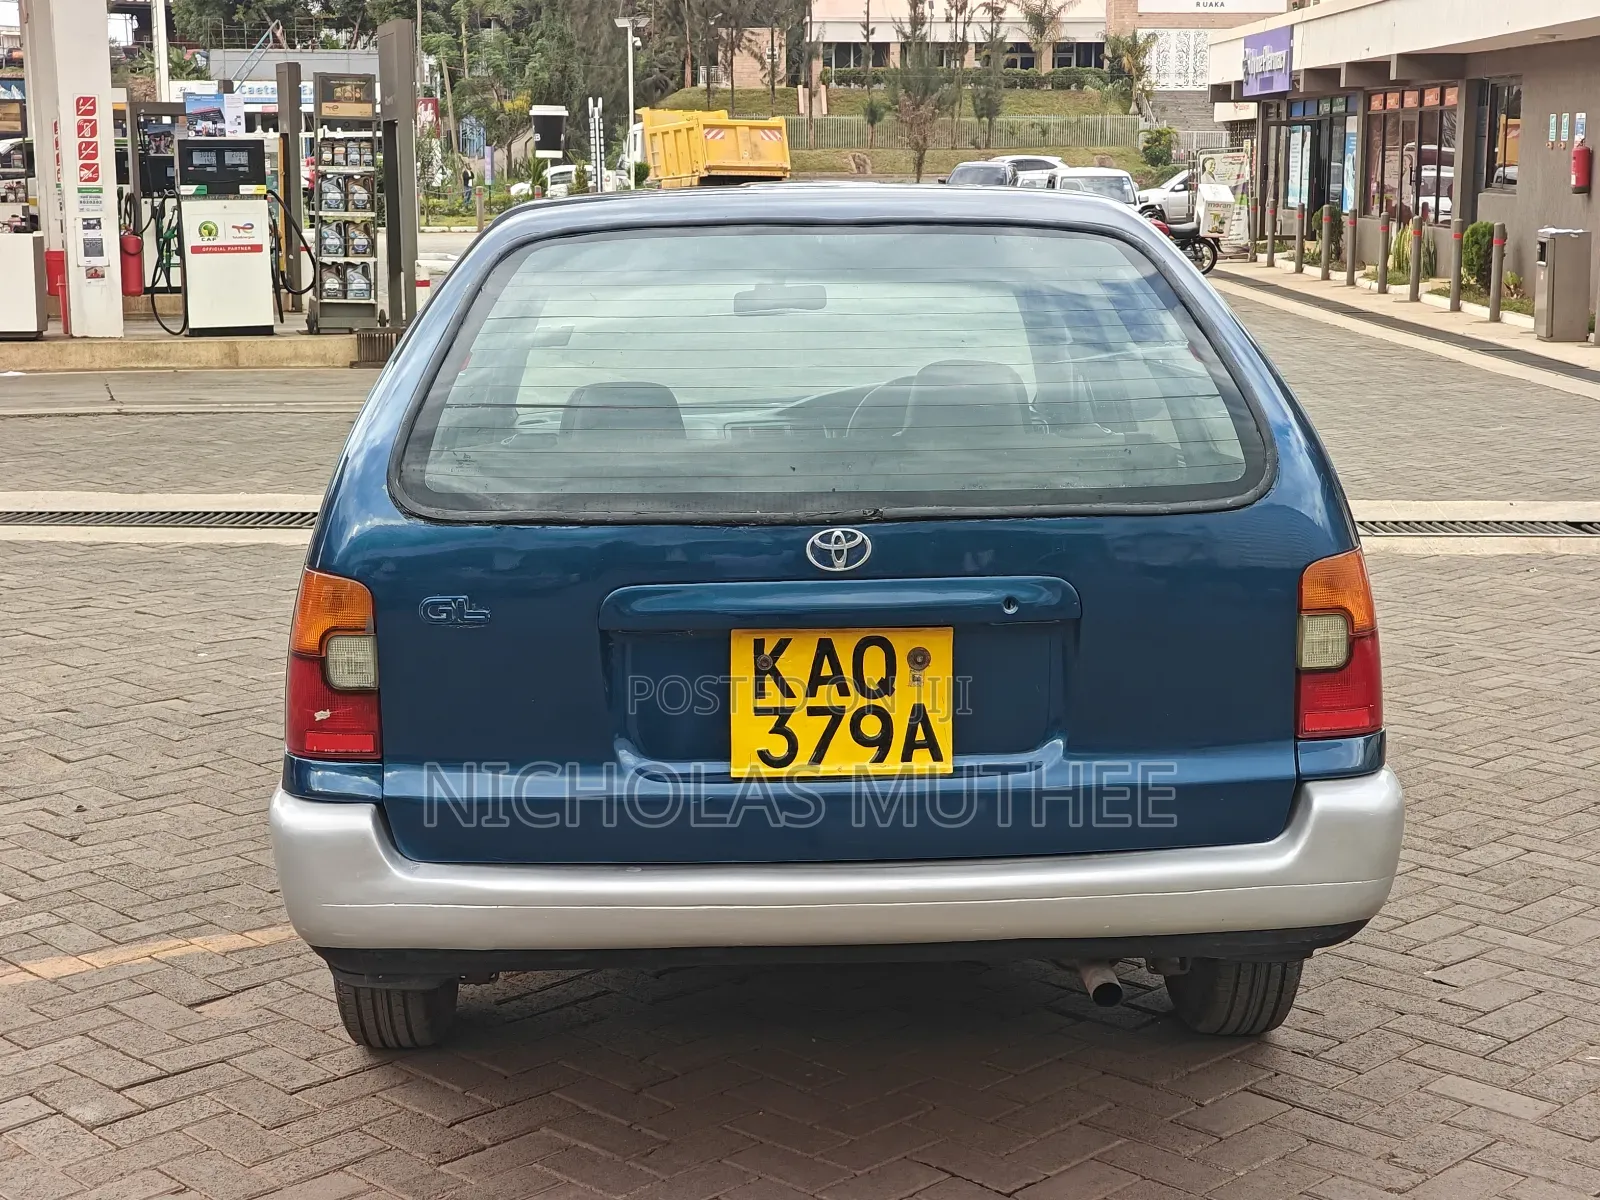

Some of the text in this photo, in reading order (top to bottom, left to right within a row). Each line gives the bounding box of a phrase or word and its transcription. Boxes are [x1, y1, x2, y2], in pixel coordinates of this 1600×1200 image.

[419, 595, 491, 626] GL
[752, 635, 897, 700] KAQ
[752, 703, 945, 769] 379A
